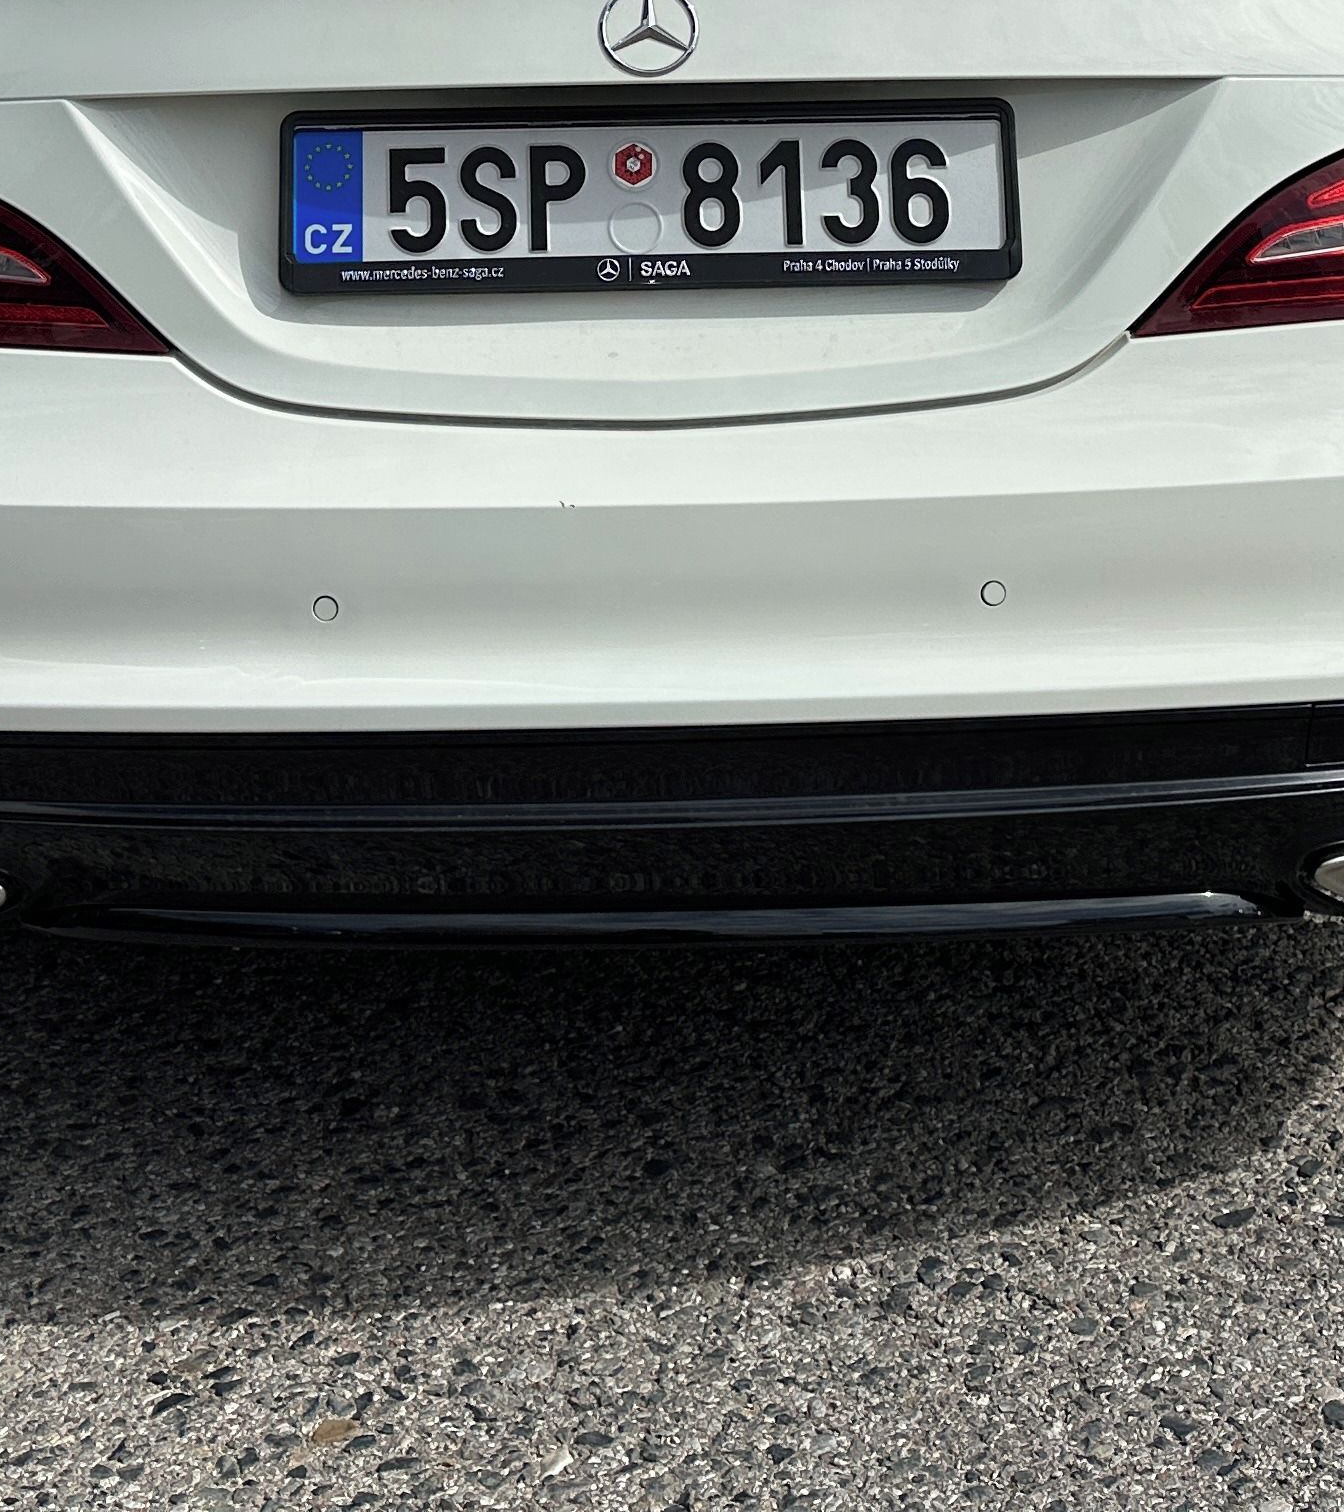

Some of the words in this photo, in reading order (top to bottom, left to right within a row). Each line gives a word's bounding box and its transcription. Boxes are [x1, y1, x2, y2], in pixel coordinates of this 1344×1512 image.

[388, 144, 587, 254] 5SP
[682, 138, 950, 247] 8136
[304, 223, 353, 255] CZ
[640, 259, 691, 277] SAGA
[783, 259, 813, 272] Praha
[815, 259, 823, 271] 4
[825, 258, 865, 271] Chodov
[873, 258, 902, 271] Praha
[904, 258, 912, 270] 5
[914, 256, 960, 272] Stodůlky
[341, 265, 505, 282] www.mercedes-benz-saga.cz
